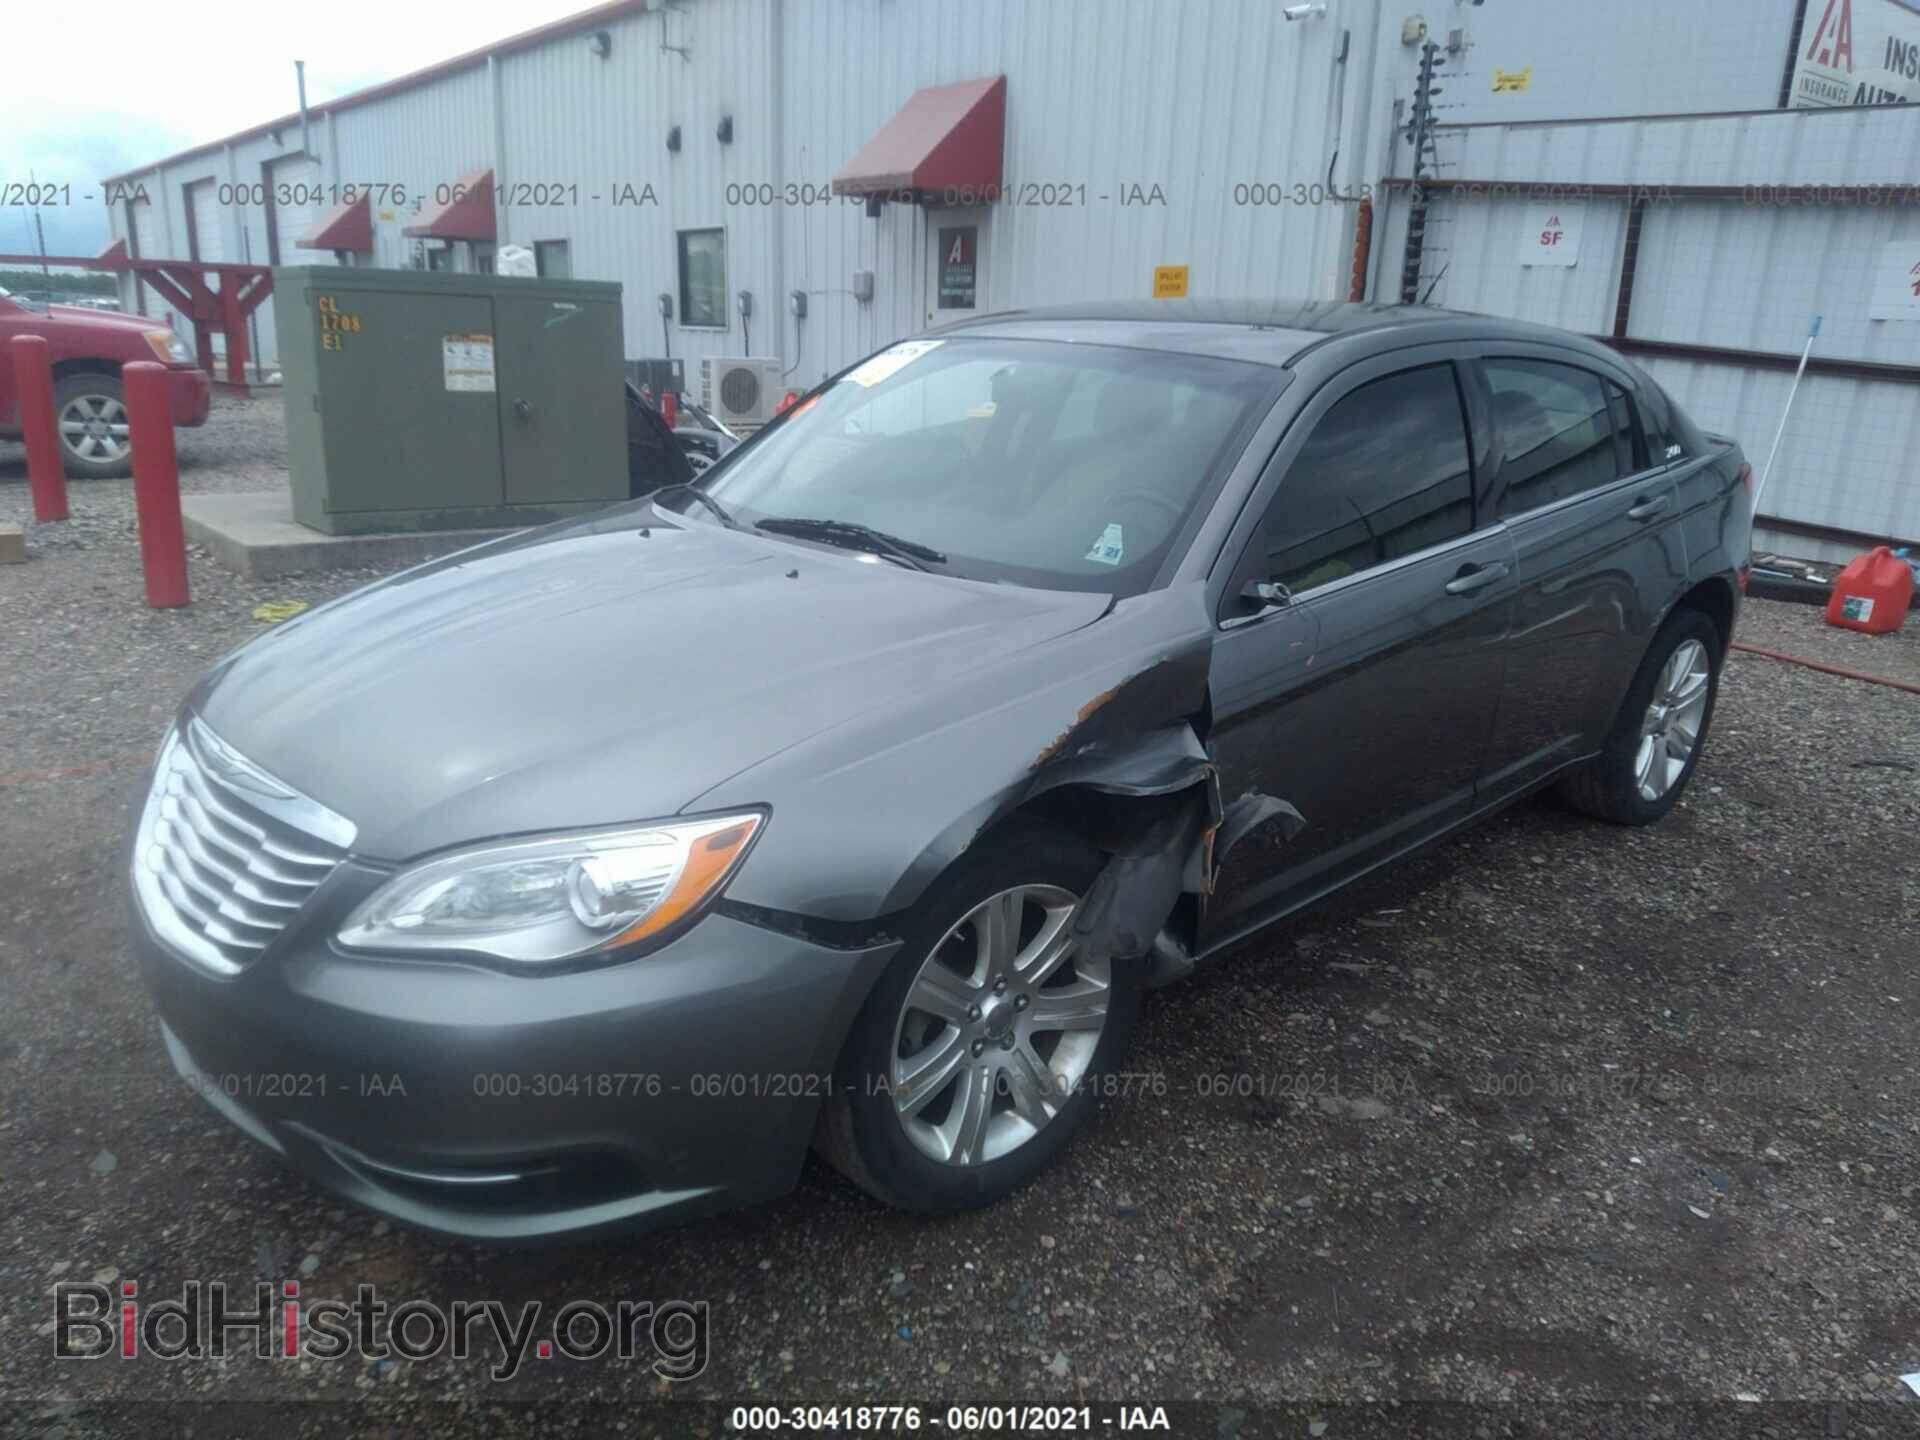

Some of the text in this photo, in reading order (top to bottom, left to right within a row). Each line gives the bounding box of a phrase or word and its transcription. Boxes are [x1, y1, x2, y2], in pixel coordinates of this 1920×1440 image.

[1884, 35, 1920, 80] INS
[1800, 77, 1849, 104] INSURANCE
[1853, 82, 1907, 105] AUT
[1540, 231, 1563, 246] SF
